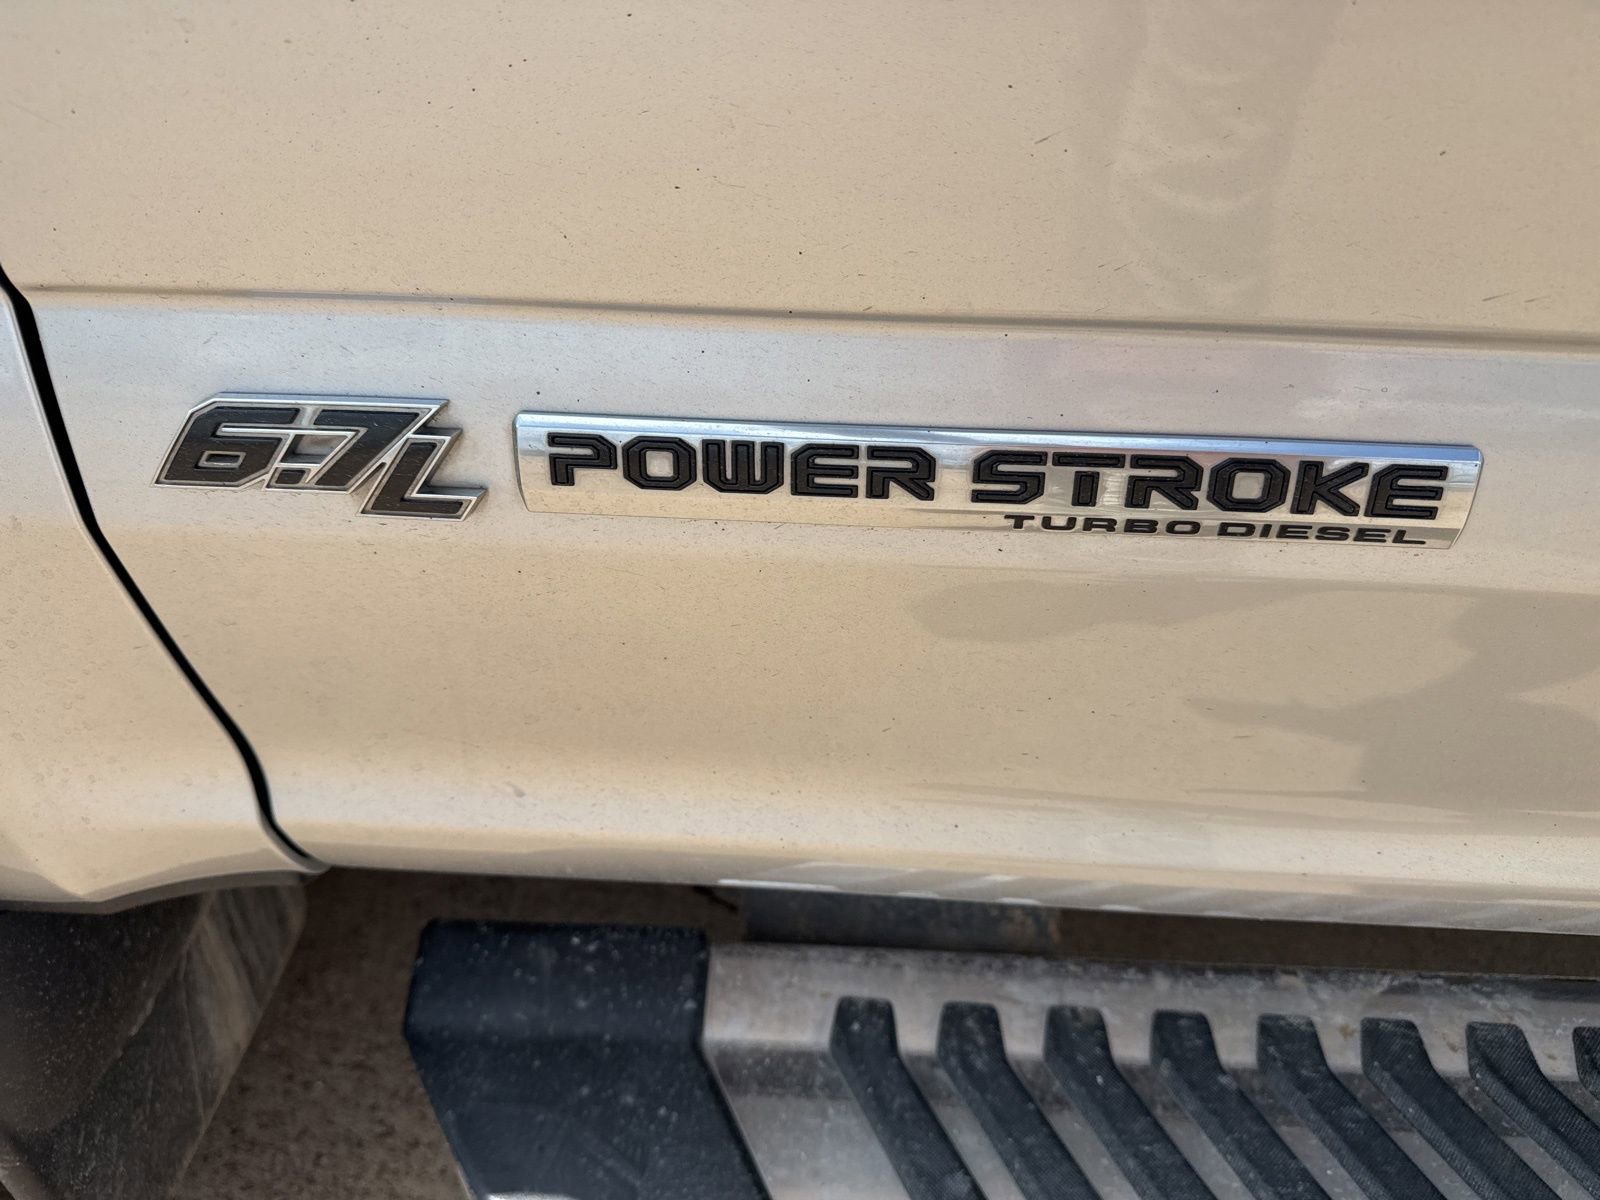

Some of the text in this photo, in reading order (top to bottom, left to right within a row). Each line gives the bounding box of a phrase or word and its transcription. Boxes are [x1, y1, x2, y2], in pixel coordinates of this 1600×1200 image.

[154, 395, 484, 519] 6.7L
[547, 432, 1449, 520] POWER STROKE
[1004, 514, 1426, 545] TURBO DIESEL
